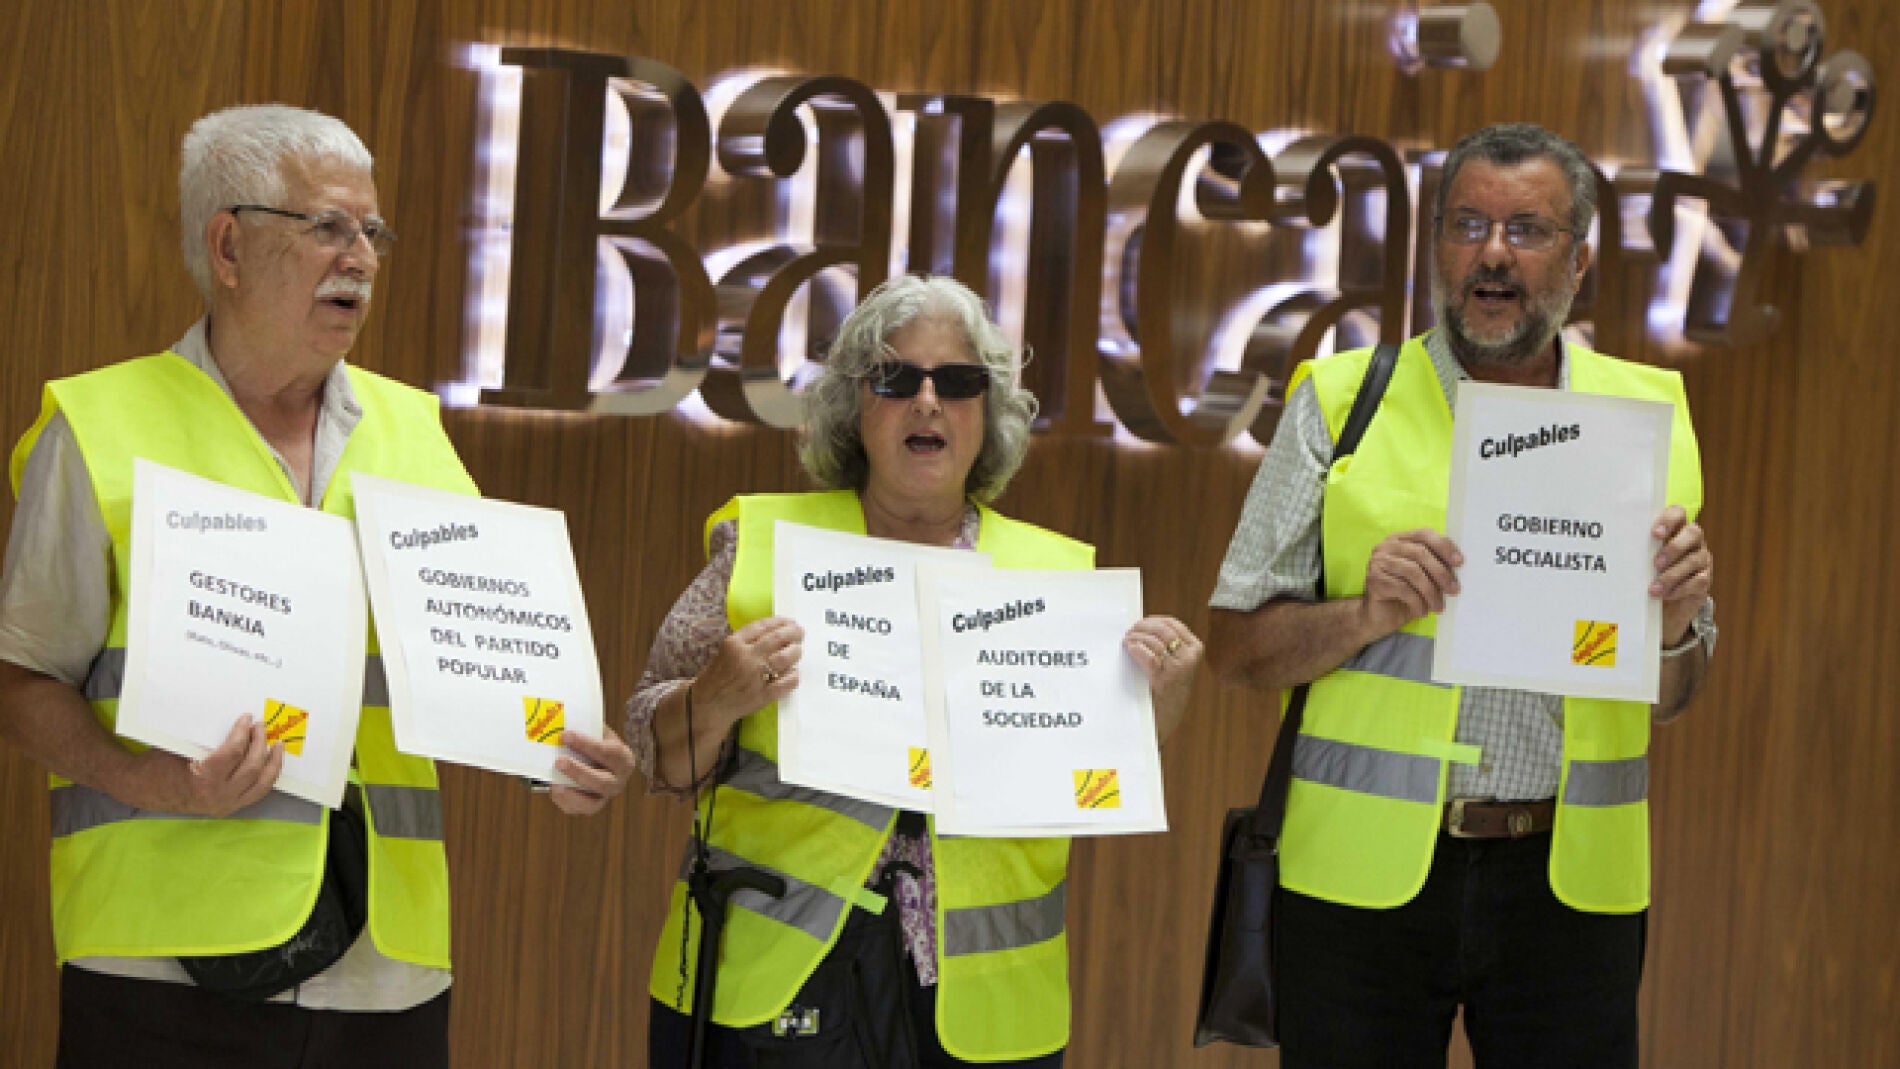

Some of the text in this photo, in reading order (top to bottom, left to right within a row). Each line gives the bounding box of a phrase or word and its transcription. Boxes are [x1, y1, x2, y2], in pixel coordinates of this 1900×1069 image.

[1479, 423, 1580, 460] Culpables
[165, 510, 268, 534] Culpables
[389, 522, 479, 550] Culpables
[1497, 513, 1603, 539] GOBIERNO
[1495, 545, 1607, 573] SOCIALISTA
[188, 570, 293, 615] GESTORES
[418, 566, 531, 599] GOBIERNOS
[802, 565, 895, 593] Culpables
[188, 599, 266, 639] BANKIA
[425, 595, 573, 633] AUTONÓMICOS
[825, 608, 892, 635] BANCO
[952, 597, 1046, 633] Culpables
[430, 626, 560, 660] DEL PARTIDO
[827, 640, 850, 660] DE
[438, 655, 530, 684] POPULAR
[976, 649, 1089, 668] AUDITORES
[827, 673, 901, 701] ESPAÑA
[979, 680, 1036, 699] DE LA
[982, 709, 1084, 729] SOCIEDAD
